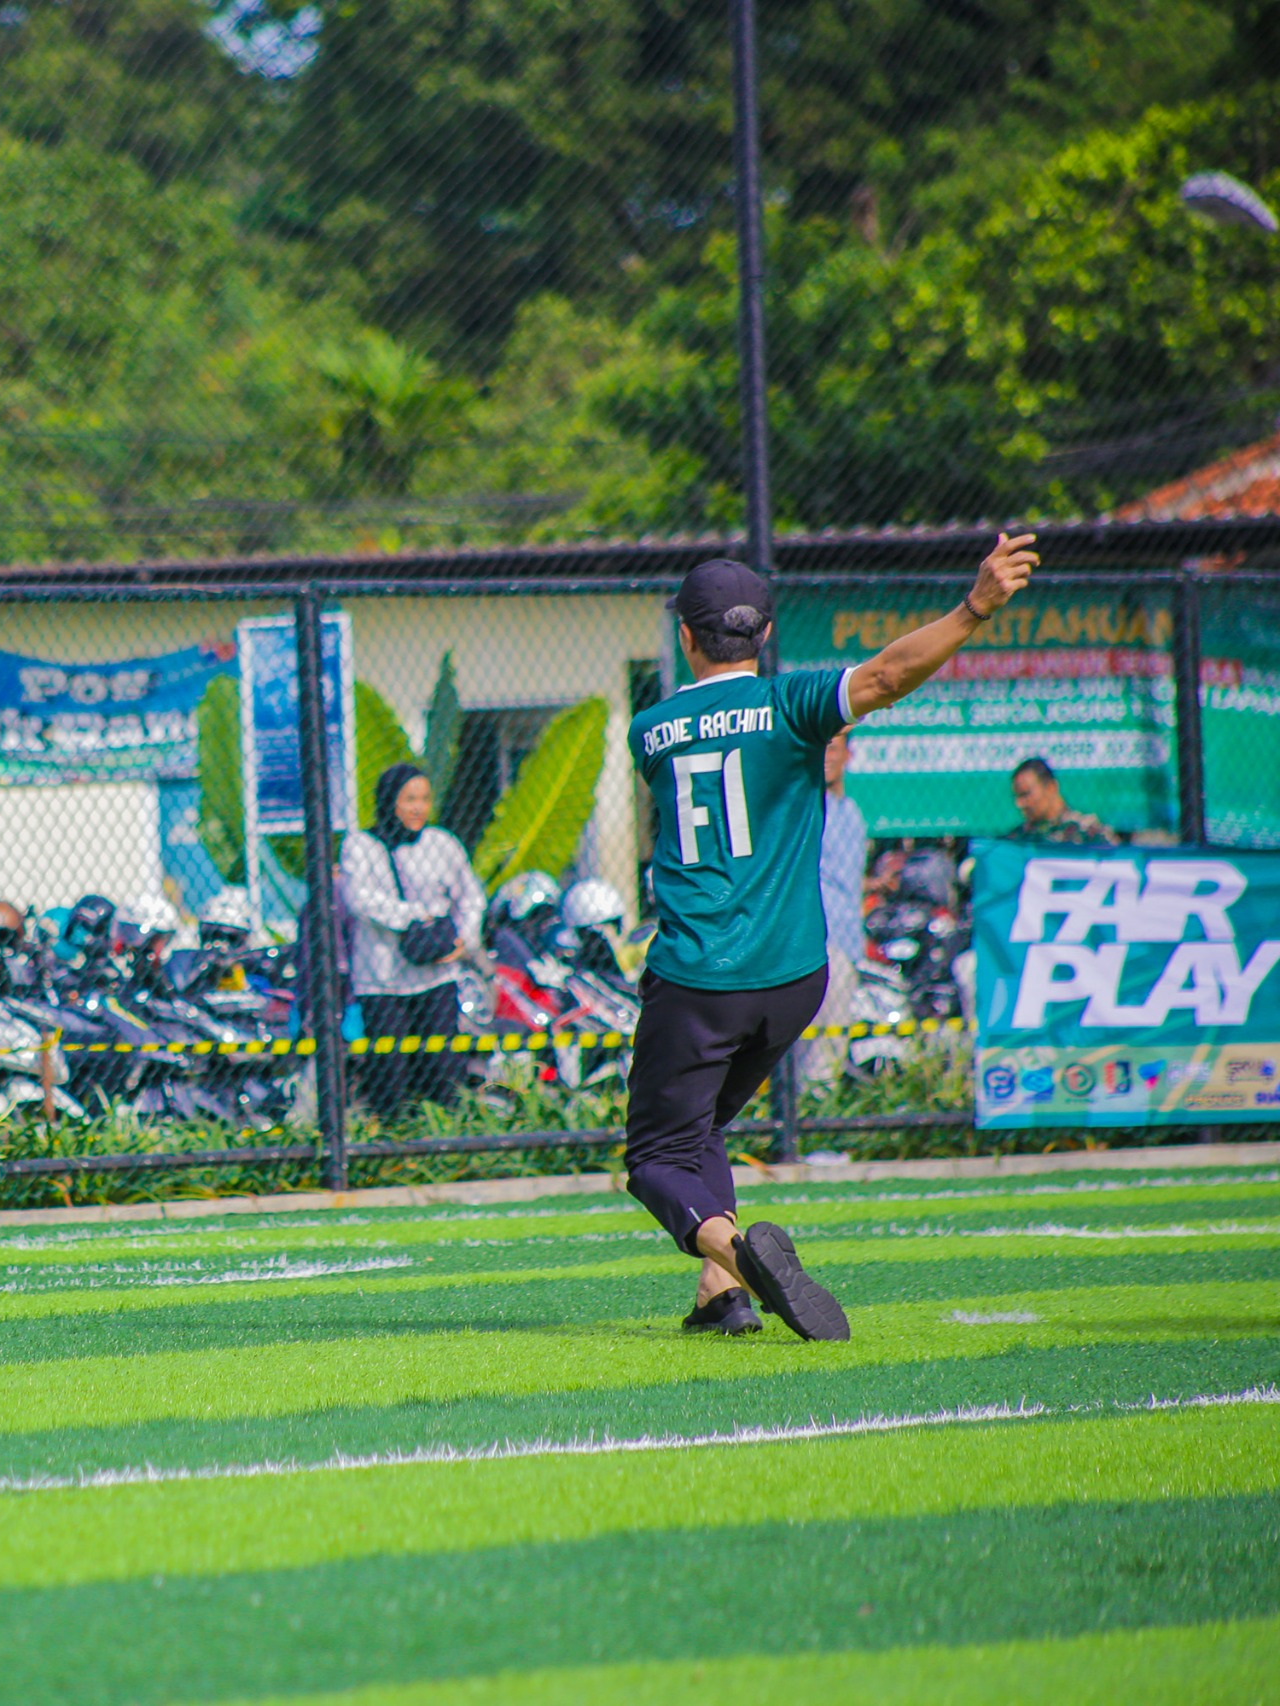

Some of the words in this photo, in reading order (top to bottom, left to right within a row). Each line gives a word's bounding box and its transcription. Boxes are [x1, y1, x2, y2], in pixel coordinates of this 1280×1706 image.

[833, 605, 1173, 649] PEMRITAHUAN
[643, 716, 693, 756] DEDIE
[699, 706, 773, 740] RACHIM
[1009, 857, 1249, 943] FAIR
[1011, 940, 1280, 1029] PLAY
